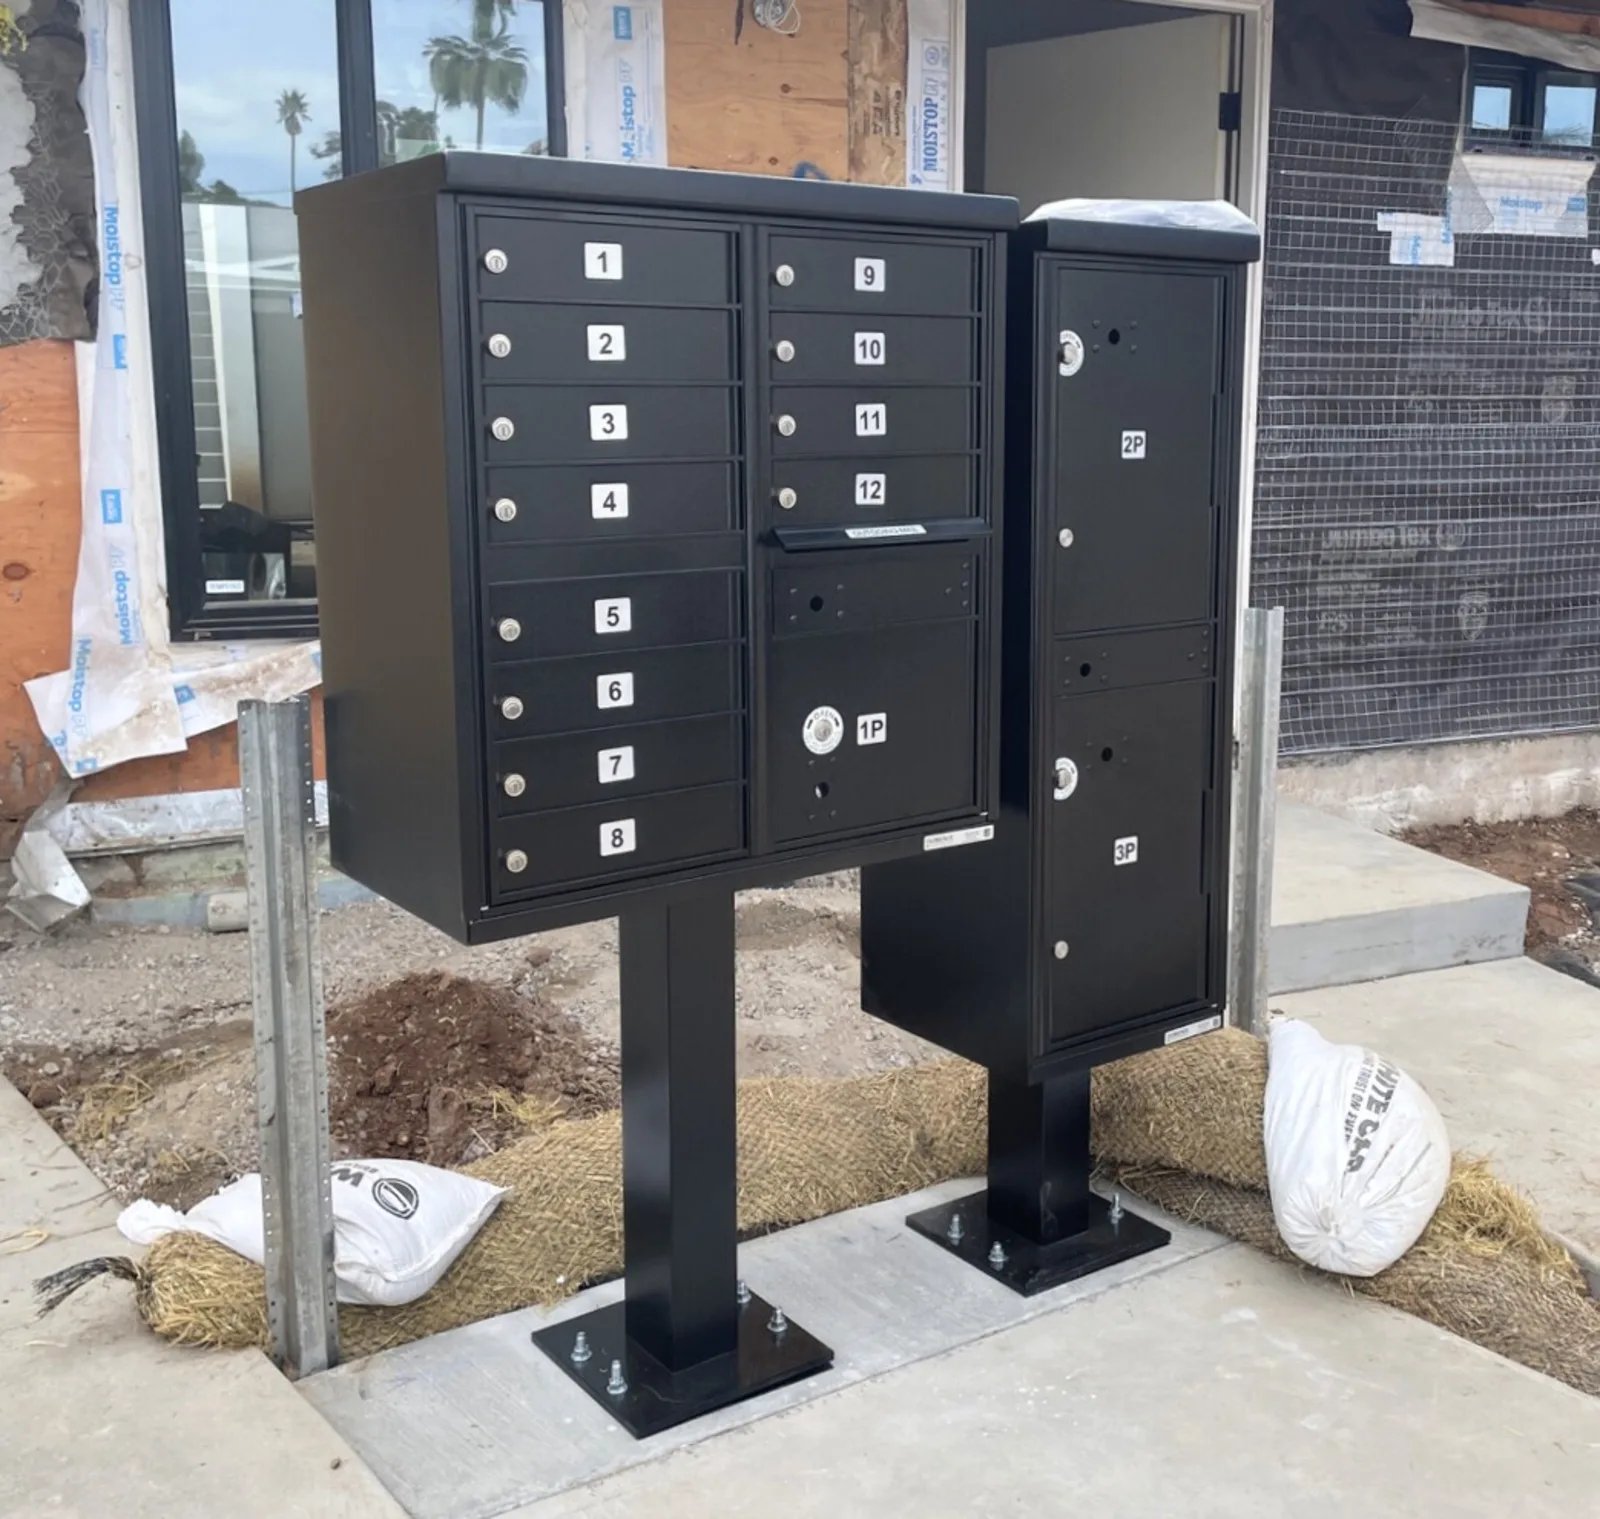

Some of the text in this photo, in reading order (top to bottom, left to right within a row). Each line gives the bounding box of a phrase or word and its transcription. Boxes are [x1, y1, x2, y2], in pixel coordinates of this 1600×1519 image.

[620, 85, 638, 162] Mistop
[922, 97, 938, 173] MOISTOP
[103, 206, 122, 286] Moistop
[597, 251, 607, 273] 1
[863, 265, 875, 286] 9
[599, 332, 613, 355] 2
[859, 339, 881, 360] 10
[602, 412, 615, 434] 3
[860, 410, 880, 430] 11
[1123, 435, 1144, 454] 2P
[860, 480, 882, 500] 12
[602, 491, 617, 512] 4
[114, 570, 131, 645] Moistop
[606, 606, 620, 627] 5
[69, 639, 92, 712] Moistop
[608, 680, 622, 702] 6
[860, 719, 884, 739] 1P
[609, 754, 622, 776] 7
[611, 827, 624, 848] 8
[1116, 842, 1136, 861] 3P
[1350, 1093, 1364, 1111] ON
